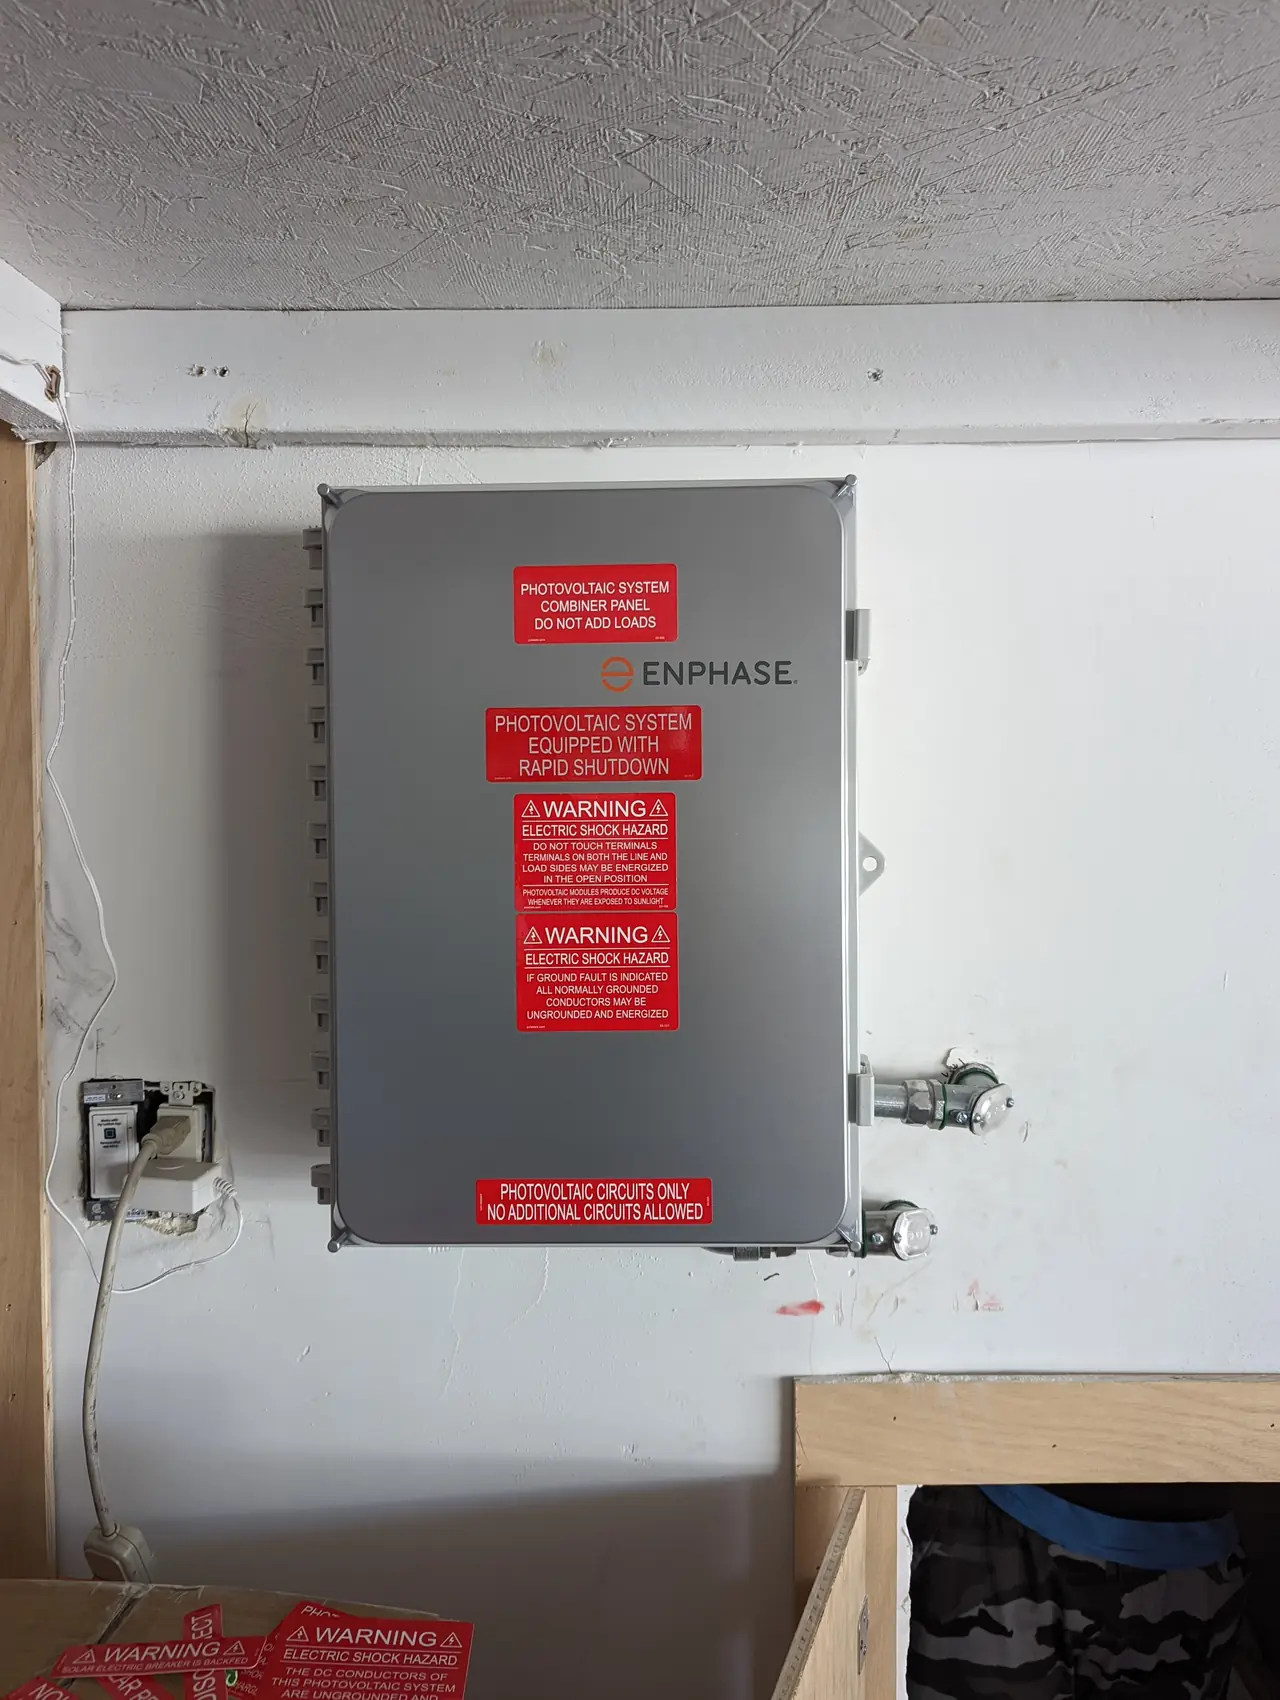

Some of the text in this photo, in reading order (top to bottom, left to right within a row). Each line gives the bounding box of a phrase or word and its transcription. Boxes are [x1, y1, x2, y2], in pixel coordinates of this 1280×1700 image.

[521, 581, 669, 595] PHOTOVOLTAIC SYSTEM
[540, 599, 650, 613] COMBINER PANEL
[534, 616, 656, 630] DO NOT ADD LOADS
[643, 660, 792, 686] ENPHASE
[495, 713, 692, 732] PHOTOVOLTAIC SYSTEM
[528, 735, 659, 755] EQUIPPED WITH
[519, 758, 669, 777] RAPID SHUTDOWN
[543, 800, 646, 818] WARNING
[522, 823, 668, 837] ELECTRIC SHOCK HAZARD
[533, 842, 657, 851] DO NOT TOUCH TERMINALS
[523, 852, 668, 862] TERMINALS ON BOTH THE LINE AND
[522, 863, 669, 873] LOAD SIDES MAY BE ENERGIZED
[544, 874, 647, 883] IN THE OPEN POSITION
[523, 887, 669, 896] PHOTOVOLTAIC MODULES PRODUCE DC VOLTAGE
[528, 898, 562, 906] WHENEVER
[563, 898, 580, 906] THEY
[594, 897, 623, 905] EXPOSED
[624, 897, 632, 905] TO
[633, 897, 664, 905] SUNLIGHT
[545, 926, 648, 944] WARNING
[525, 952, 669, 965] ELECTRIC SHOCK HAZARD
[526, 972, 668, 982] IF GROUND FAULT IS INDICATED
[536, 985, 658, 995] ALL NORMALLY GROUNDED
[546, 997, 646, 1007] CONDUCTORS MAY BE
[527, 1010, 668, 1020] UNGROUNDED AND ENERGIZED
[500, 1183, 690, 1201] PHOTOVOLTAIC CIRCUITS ONLY
[487, 1203, 703, 1221] NO ADDITIONAL CIRCUITS ALLOWED
[316, 1627, 437, 1647] WARNING
[104, 1641, 221, 1663] WARNING
[283, 1648, 350, 1662] ELECTRIC
[352, 1651, 400, 1664] SHOCK
[403, 1653, 457, 1666] HAZARD
[62, 1665, 94, 1674] SOLAR
[96, 1663, 143, 1672] ELECTRIC
[145, 1660, 190, 1671] BREAKER
[203, 1657, 249, 1666] BACKFED
[285, 1667, 449, 1681] THE DC CONDUCTORS OF
[272, 1677, 456, 1693] THIS PHOTOVOLTAIC SYSTEM
[281, 1690, 309, 1700] ARE
[312, 1691, 408, 1700] UNGROUNDED
